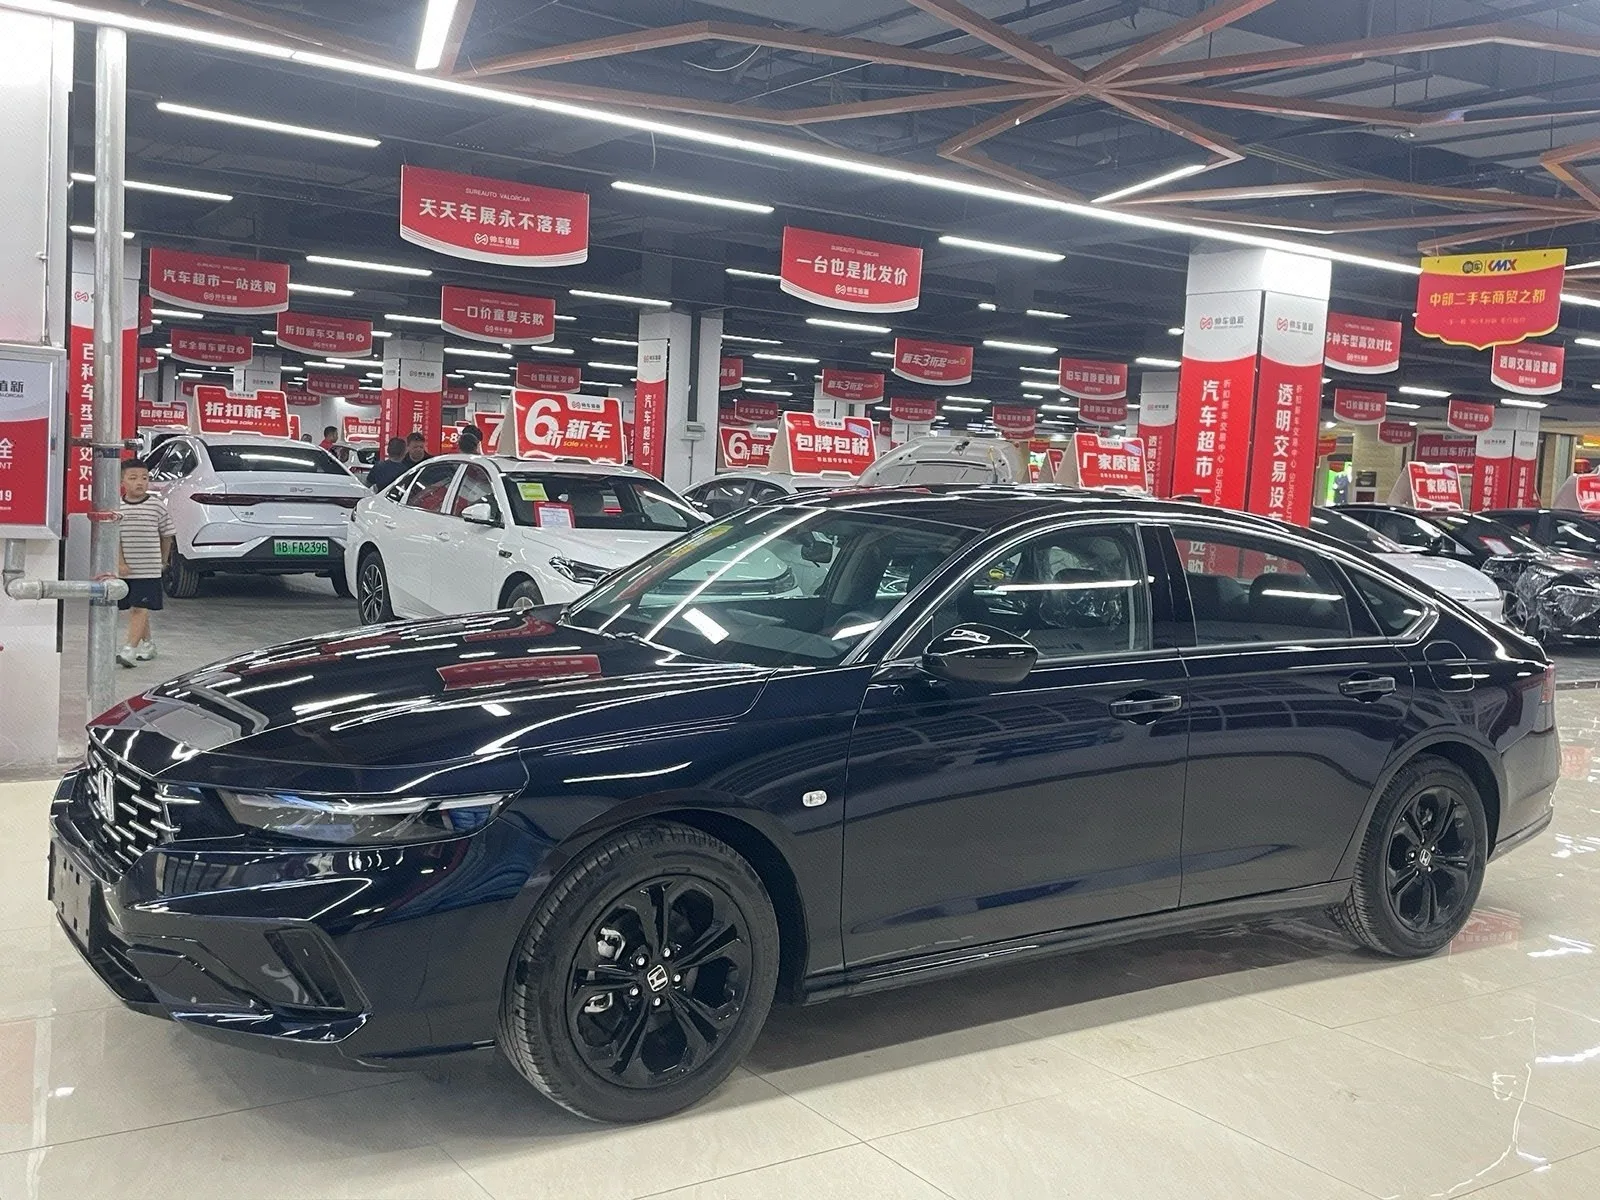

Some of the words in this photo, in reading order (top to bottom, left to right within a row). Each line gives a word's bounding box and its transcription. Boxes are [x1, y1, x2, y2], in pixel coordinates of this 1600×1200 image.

[419, 197, 572, 235] 天天车展永不落幕
[163, 268, 277, 294] 汽车超市一站选购
[796, 255, 908, 286] 一台也是批发价
[1429, 288, 1546, 307] 中部二手车商贸之都
[452, 305, 544, 327] 一口价童叟无欺
[285, 324, 365, 343] 折扣新车交易中心
[1499, 355, 1558, 375] 透明交易没套路
[204, 401, 282, 420] 折扣新车
[795, 433, 870, 456] 包牌包税
[1083, 452, 1141, 473] 厂家质保
[1416, 478, 1458, 493] 厂家质保
